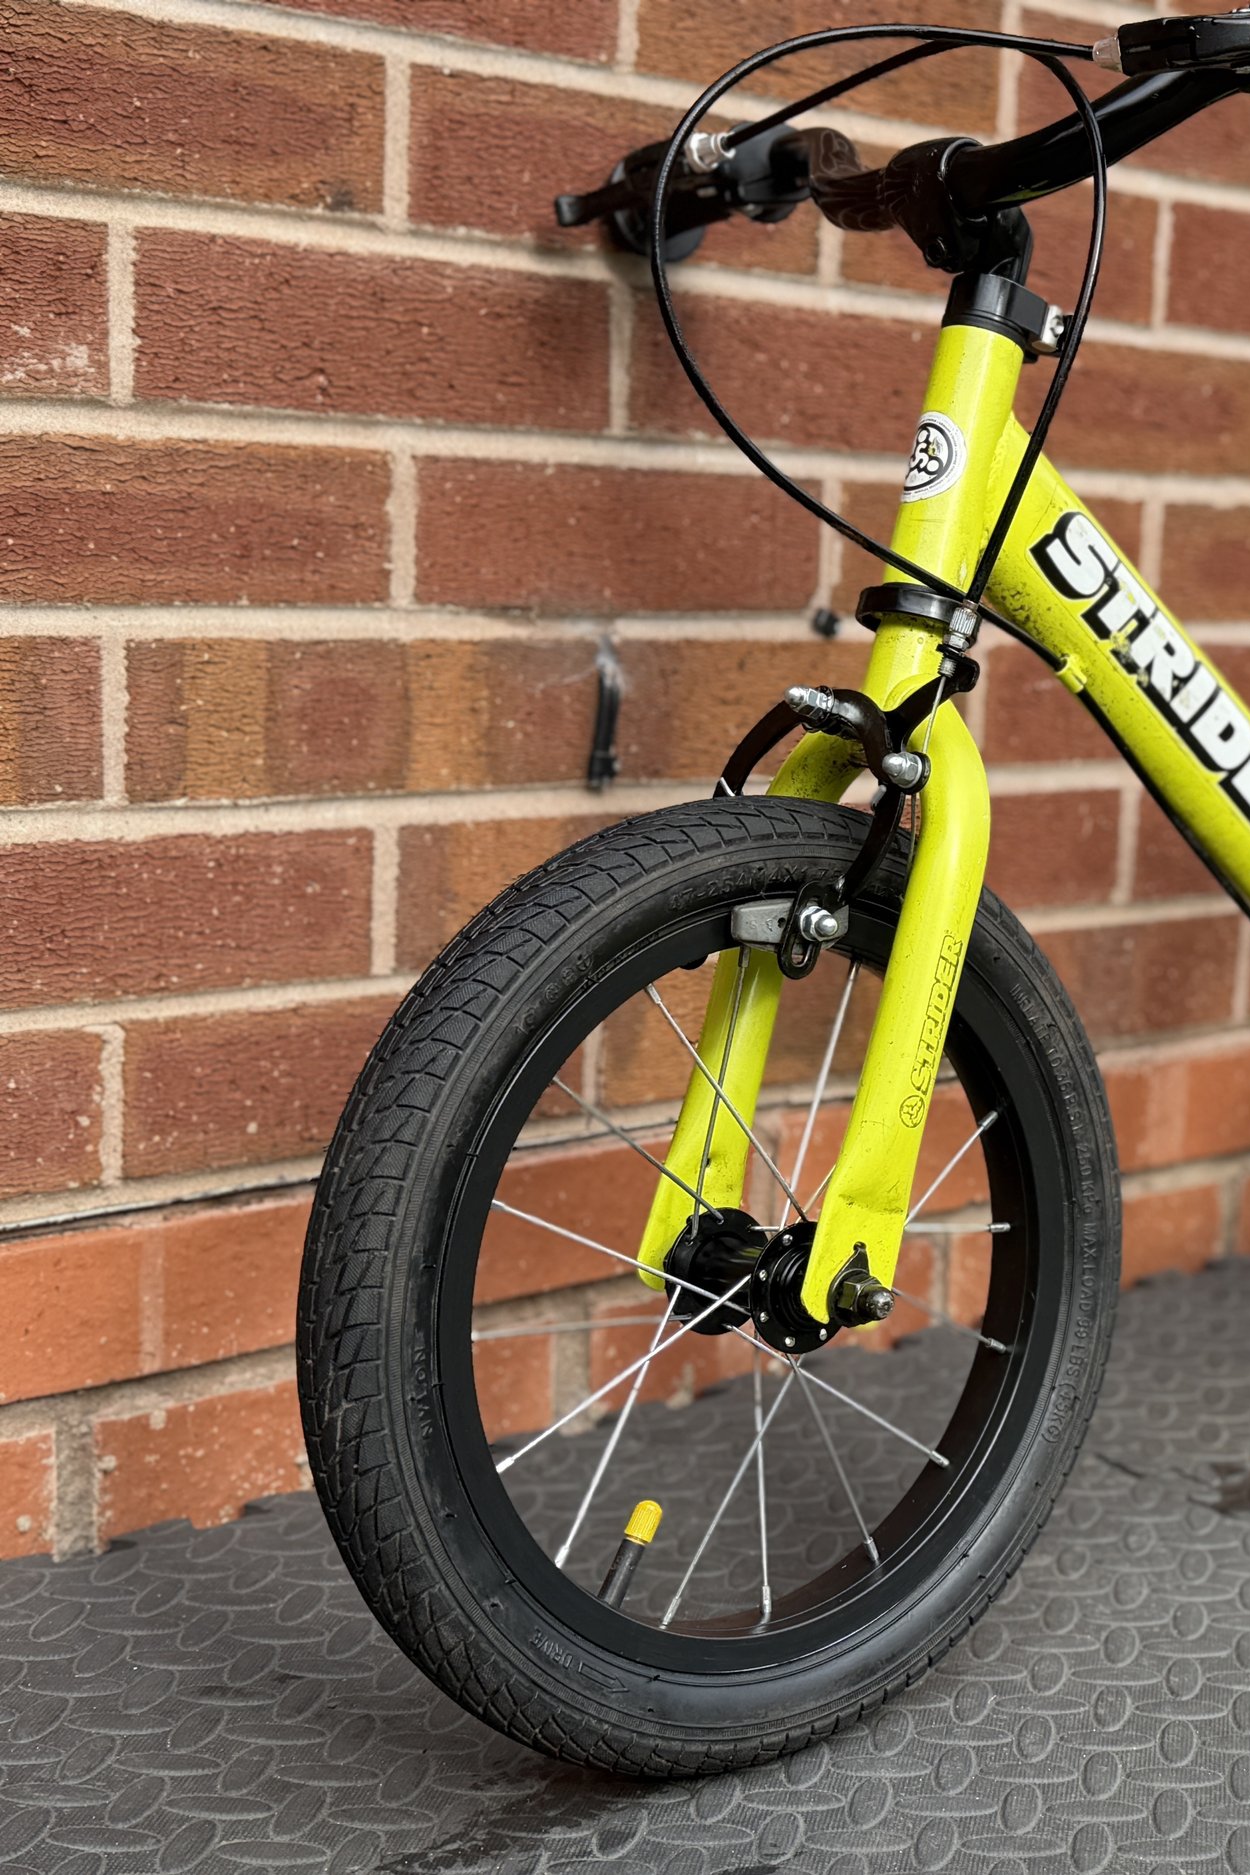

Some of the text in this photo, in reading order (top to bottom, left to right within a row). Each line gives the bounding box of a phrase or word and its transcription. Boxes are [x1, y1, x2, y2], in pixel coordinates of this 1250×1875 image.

[910, 934, 963, 1096] STRIDER
[1009, 983, 1051, 1042] INFLATE
[1045, 1046, 1064, 1068] TO
[1073, 1317, 1090, 1340] 99
[1066, 1344, 1086, 1378] LBS
[529, 1627, 573, 1671] DRIVE
